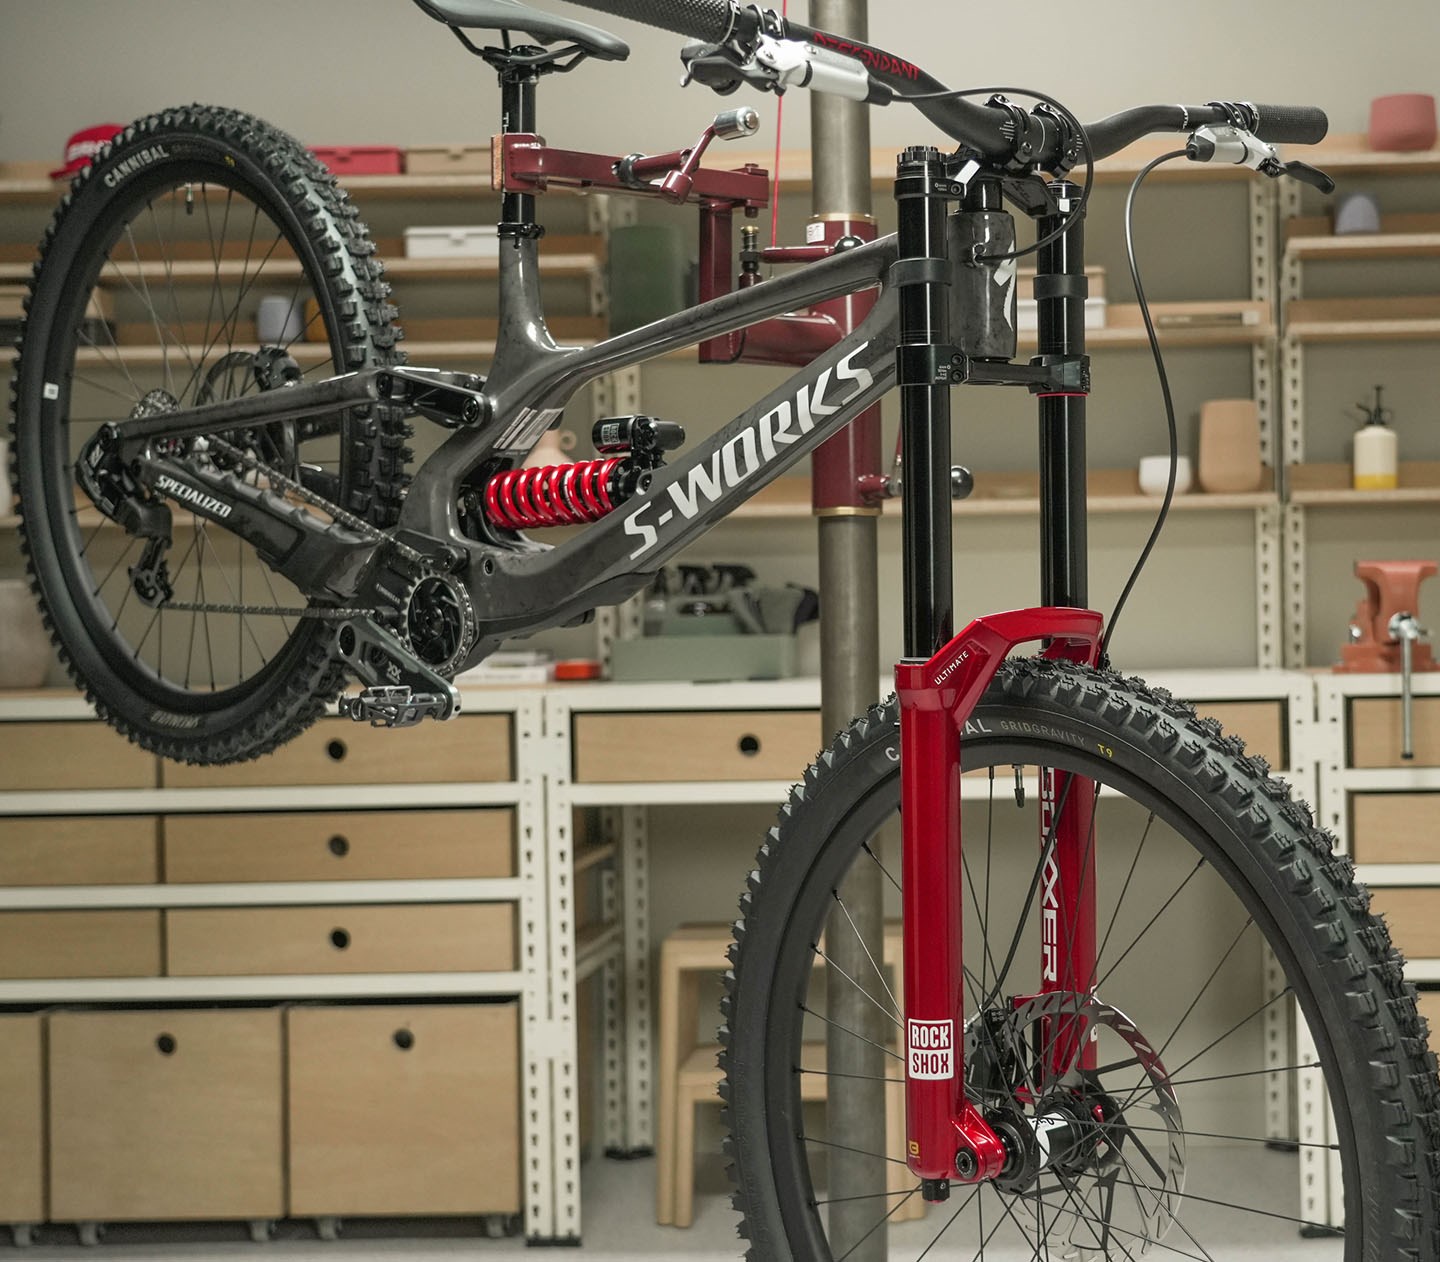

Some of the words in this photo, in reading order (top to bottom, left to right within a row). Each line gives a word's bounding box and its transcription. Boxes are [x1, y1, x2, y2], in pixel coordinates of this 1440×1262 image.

[104, 145, 169, 187] CANNIBAL
[624, 341, 873, 560] S-WORKS
[155, 475, 232, 518] SPECIALIZED
[934, 650, 970, 686] ULTIMATE
[1097, 744, 1113, 758] T9
[911, 1025, 949, 1048] ROCK
[912, 1053, 949, 1075] SHOX
